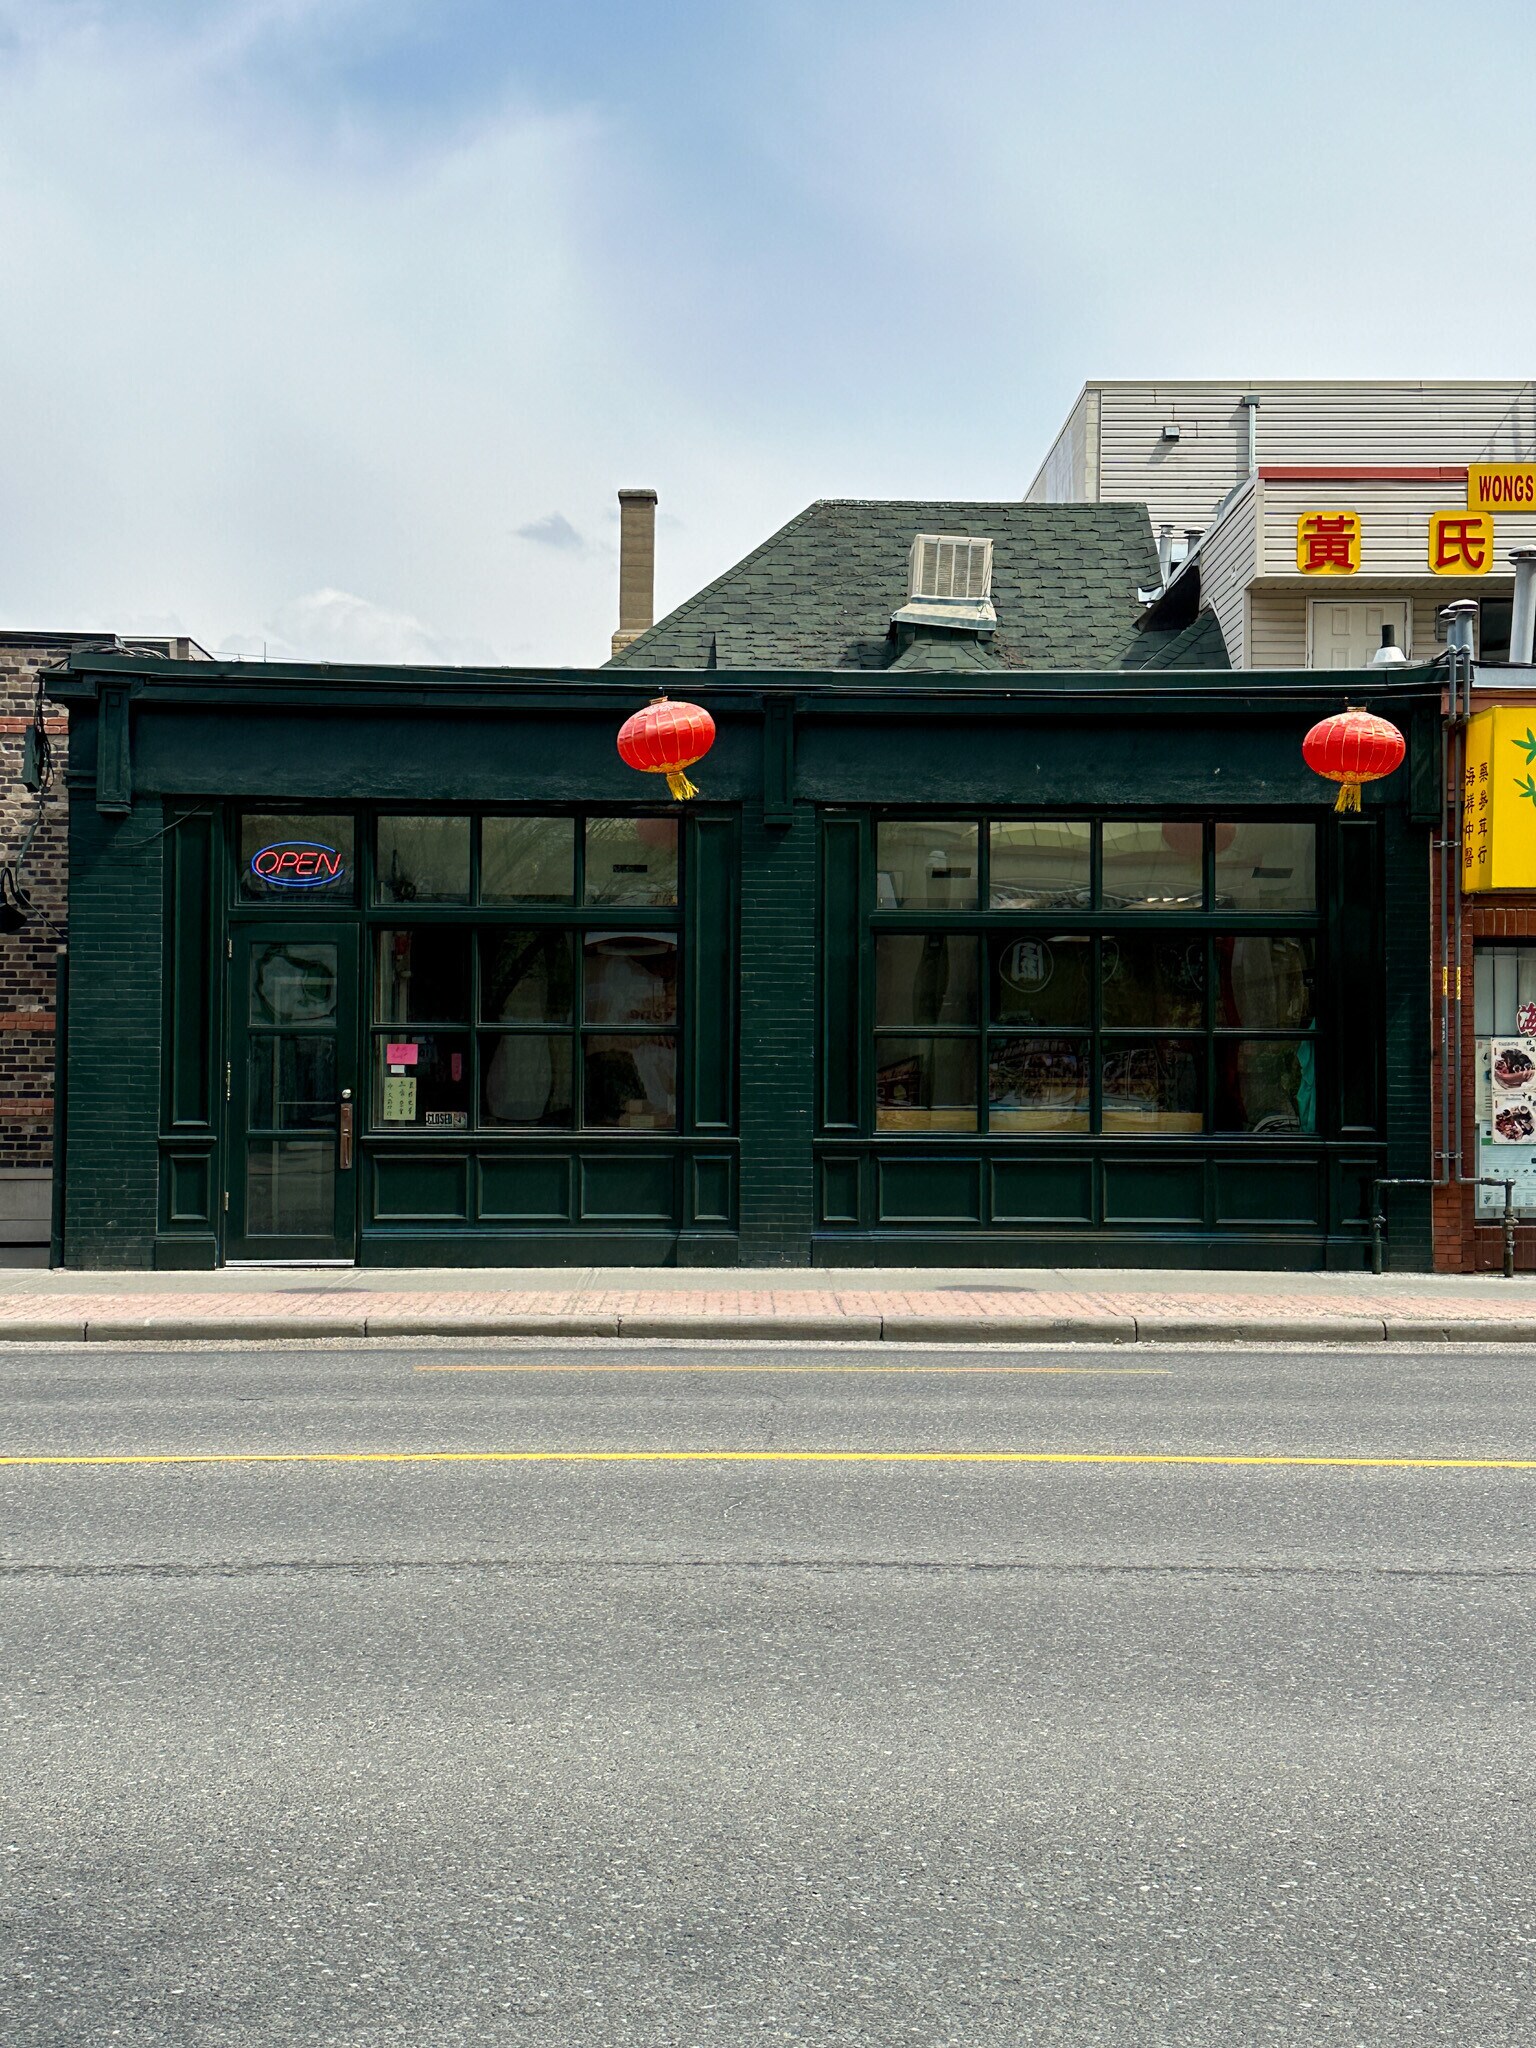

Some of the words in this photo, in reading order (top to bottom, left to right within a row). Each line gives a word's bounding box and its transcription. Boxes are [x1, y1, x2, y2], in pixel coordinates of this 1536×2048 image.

[1479, 475, 1534, 502] WONGS
[255, 851, 342, 875] OPEN
[427, 1113, 452, 1125] CLOSED
